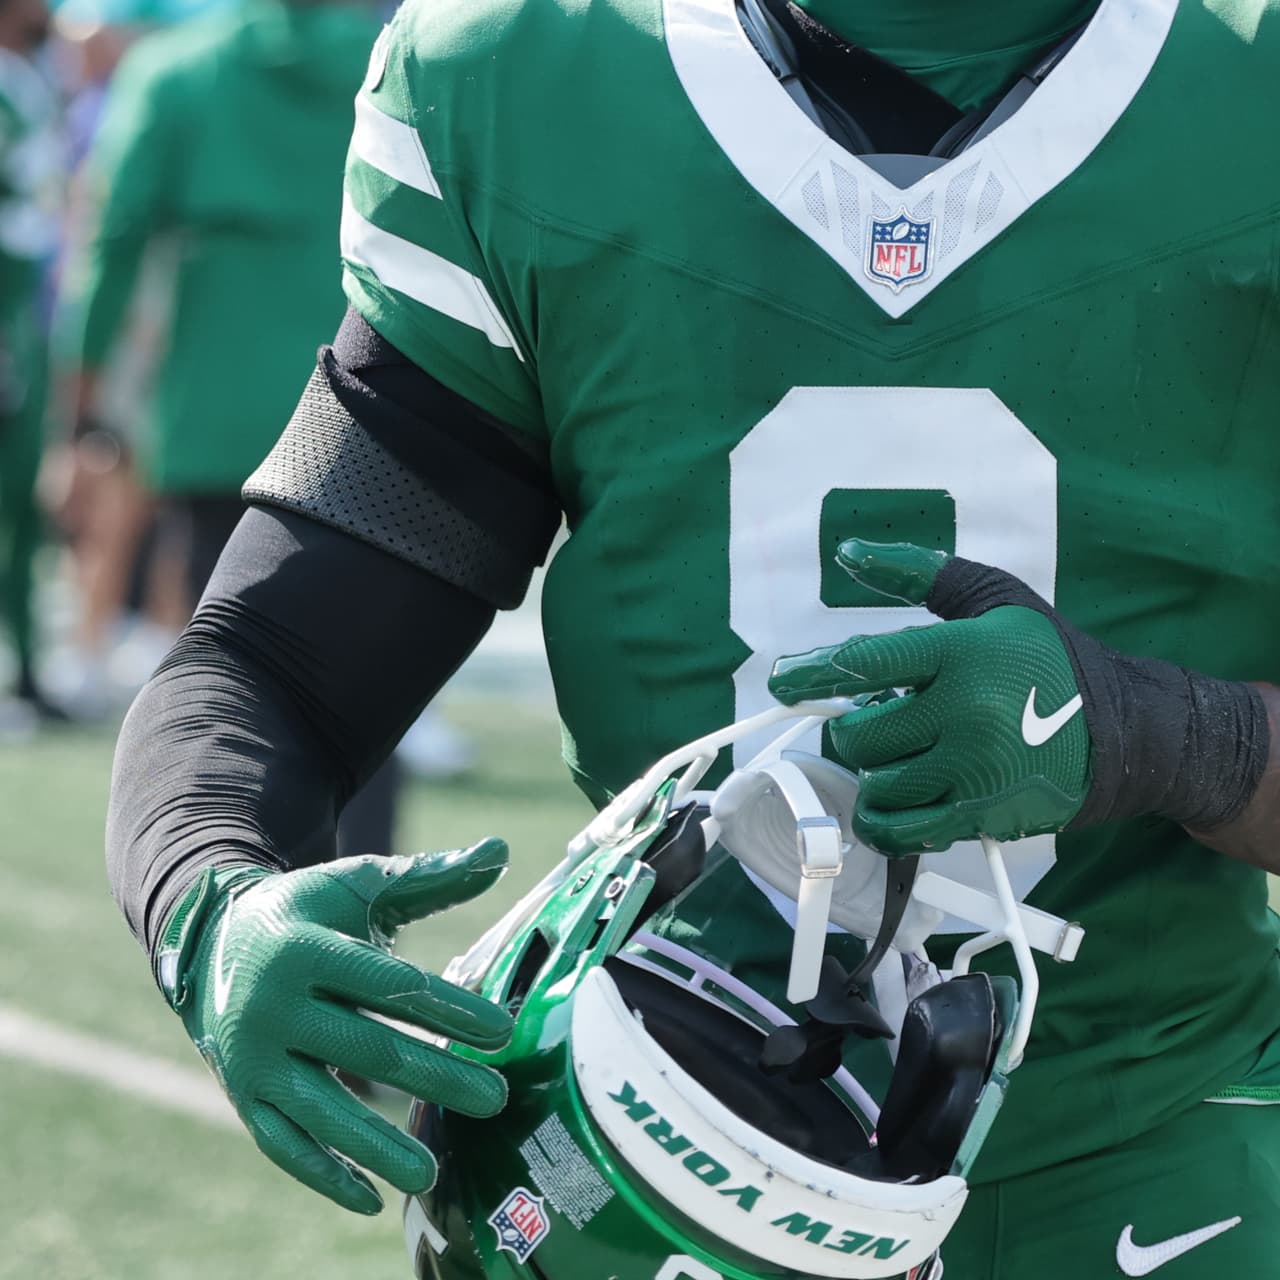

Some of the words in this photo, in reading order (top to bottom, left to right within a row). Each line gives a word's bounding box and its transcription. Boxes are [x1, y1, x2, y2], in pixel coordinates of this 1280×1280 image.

[875, 244, 922, 276] NFL
[606, 1080, 763, 1213] YORK
[508, 1195, 544, 1242] NFL
[770, 1211, 910, 1260] NEW
